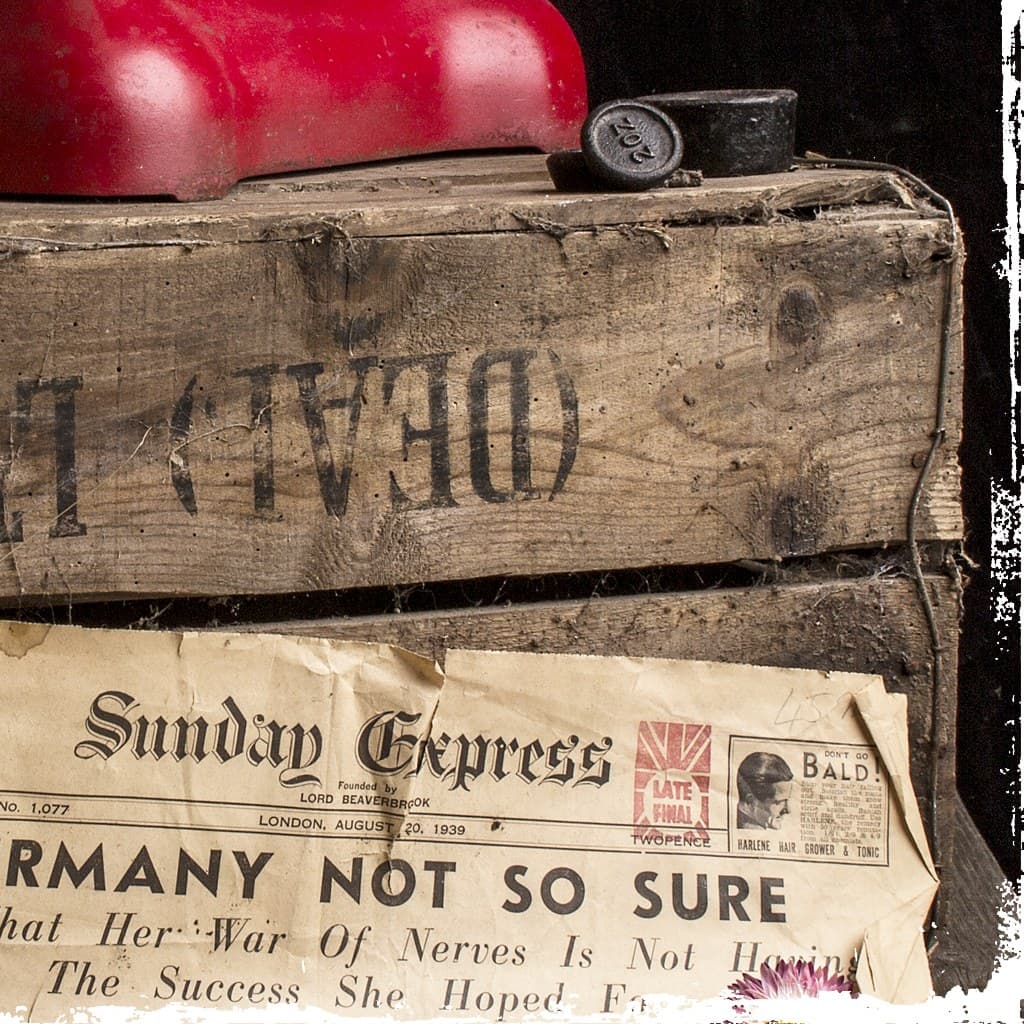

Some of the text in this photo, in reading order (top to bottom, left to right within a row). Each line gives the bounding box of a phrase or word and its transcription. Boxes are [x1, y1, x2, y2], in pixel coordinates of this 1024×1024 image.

[74, 690, 614, 791] Sunday Express
[855, 752, 869, 760] GO
[300, 792, 334, 804] LORD
[338, 781, 397, 795] Founded by
[653, 779, 693, 801] LATE
[653, 803, 693, 825] FINAL
[335, 820, 394, 832] AUGUST
[433, 823, 466, 836] 1939
[631, 834, 712, 848] TWOPENCE
[737, 838, 880, 858] HARLENE HAIR GROWER & TONIC
[319, 856, 456, 908] NOT
[502, 865, 585, 916] SO
[633, 871, 788, 924] SURE
[320, 924, 372, 969] Of
[398, 927, 527, 966] Nerves
[559, 935, 593, 969] Is
[626, 937, 696, 972] Not
[46, 960, 120, 997] The
[153, 965, 301, 1005] Success
[335, 974, 404, 1010] She
[439, 979, 565, 1022] Hoped
